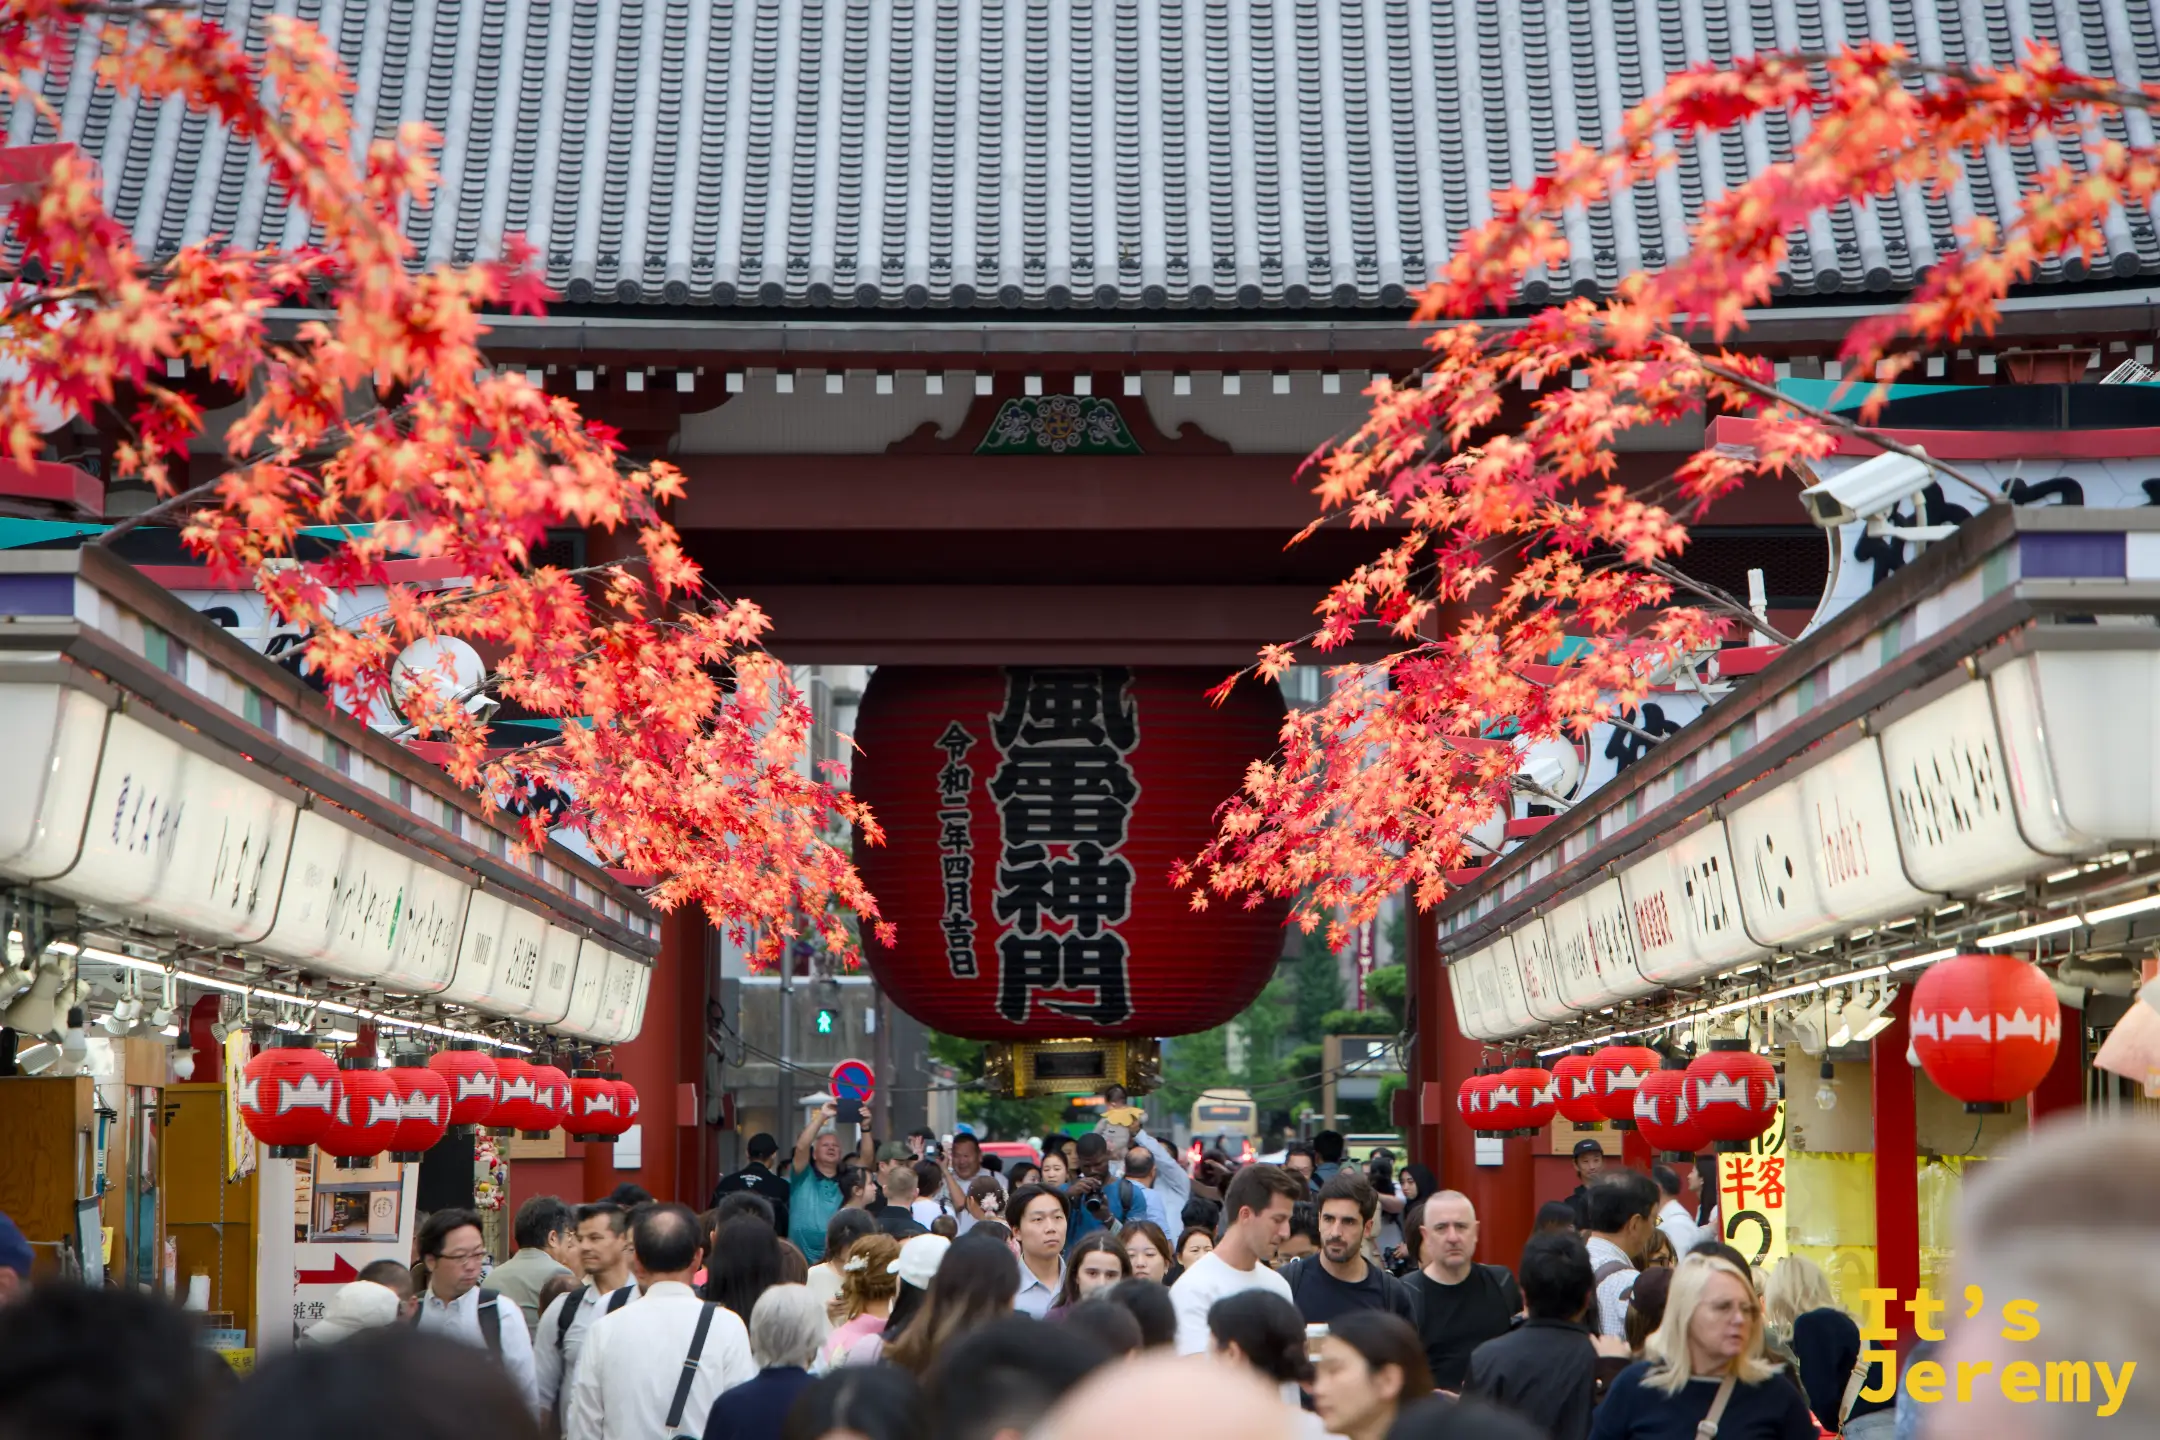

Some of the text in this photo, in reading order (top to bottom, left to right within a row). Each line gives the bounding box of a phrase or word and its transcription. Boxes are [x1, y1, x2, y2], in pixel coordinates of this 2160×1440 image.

[934, 721, 979, 979] 令和二年四月吉日
